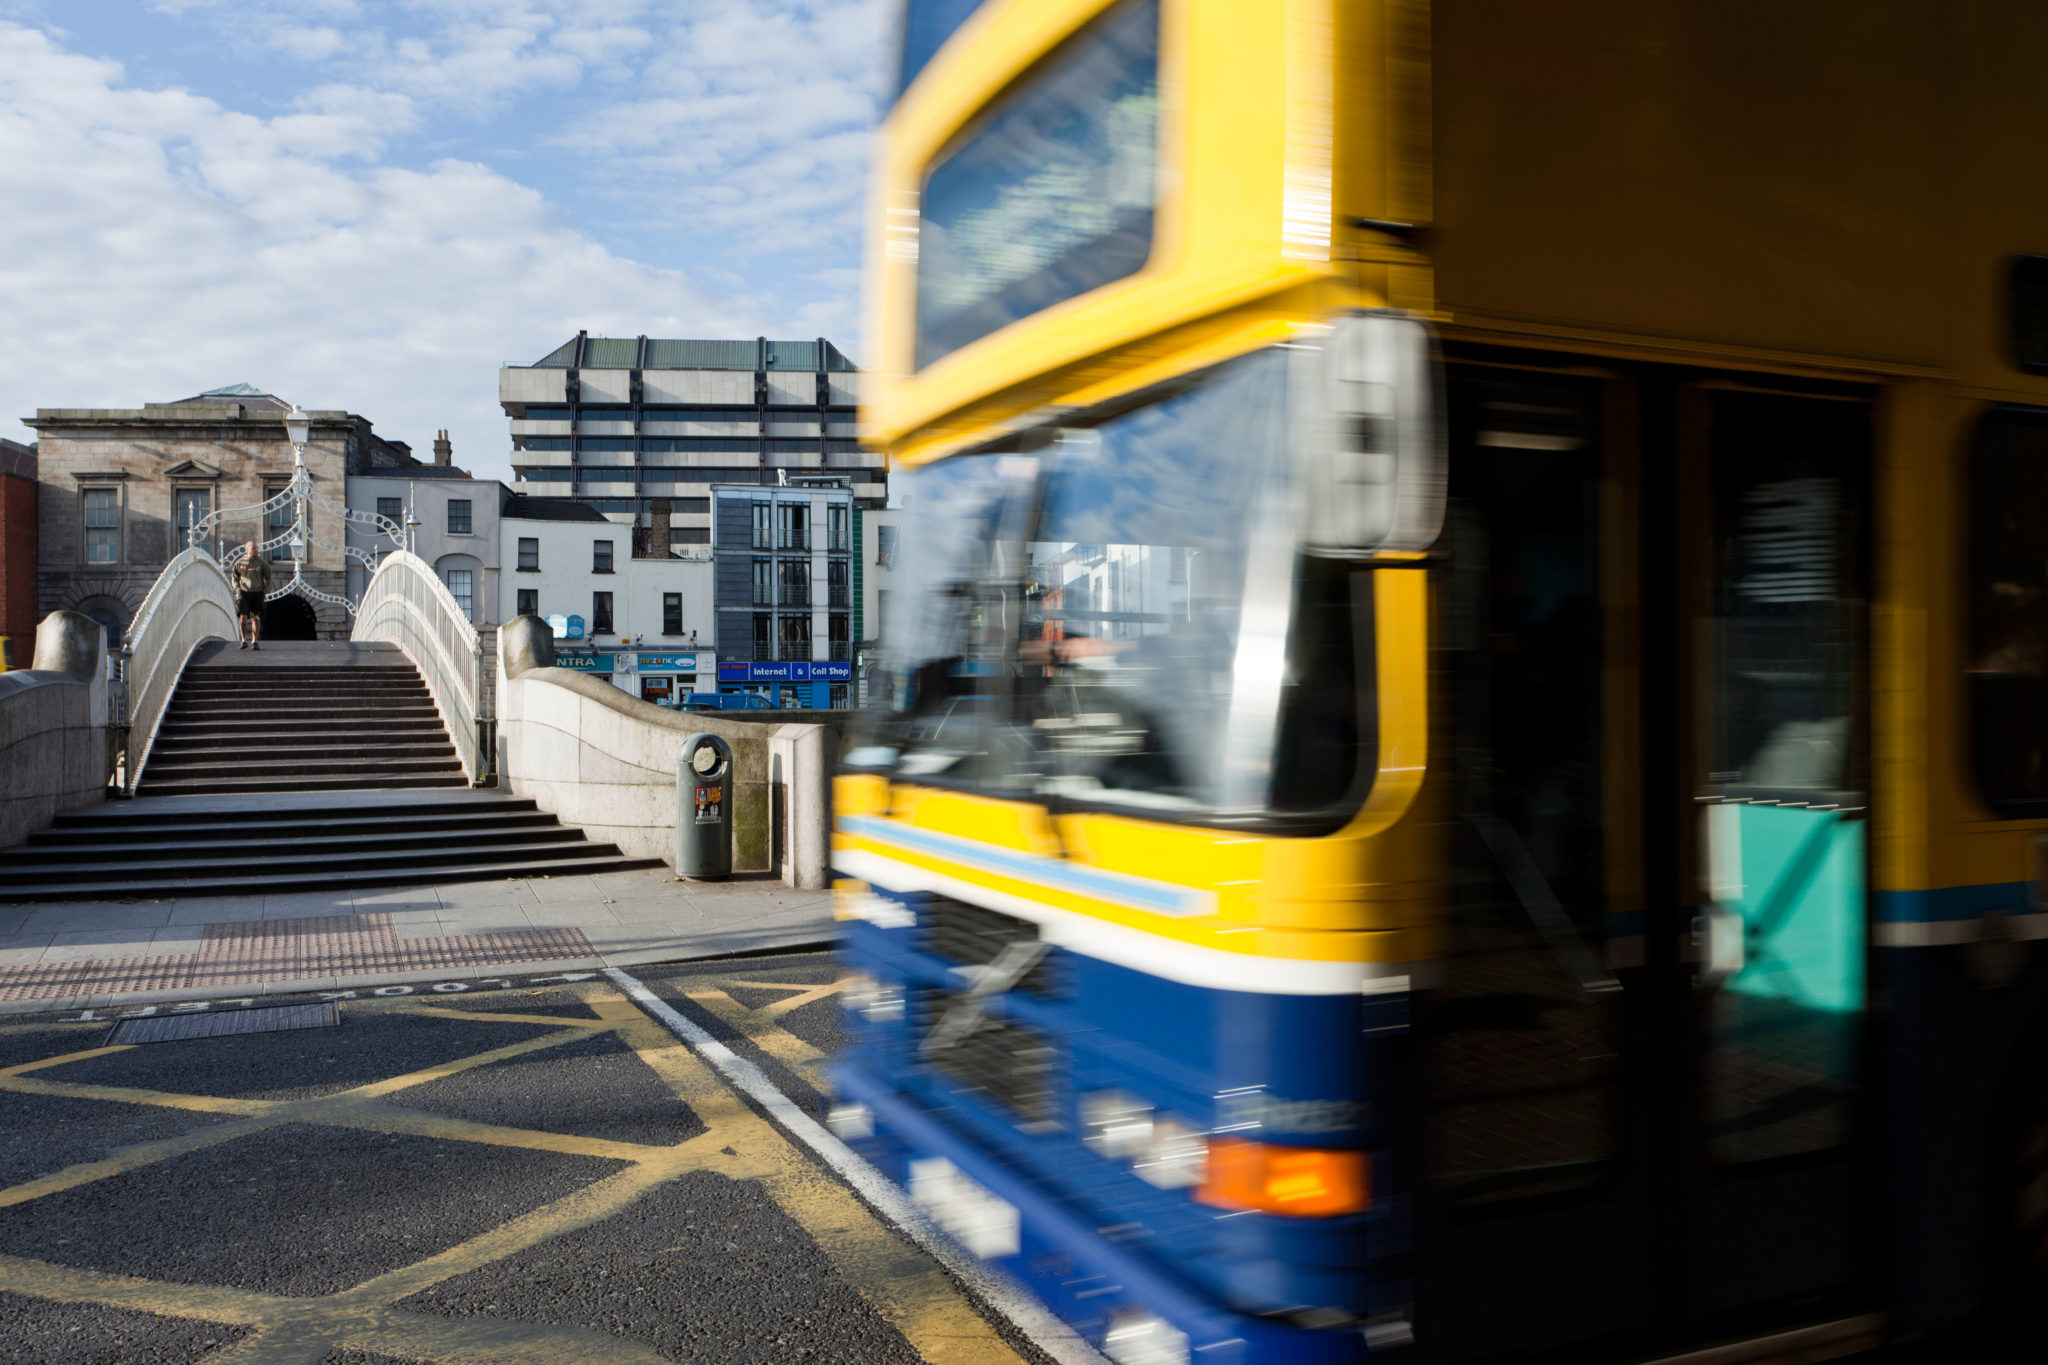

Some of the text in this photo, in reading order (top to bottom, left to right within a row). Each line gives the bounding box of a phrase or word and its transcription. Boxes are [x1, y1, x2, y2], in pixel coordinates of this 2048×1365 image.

[812, 667, 827, 675] Call
[829, 667, 849, 677] Shop
[57, 978, 512, 1023] LOOK LEFT
